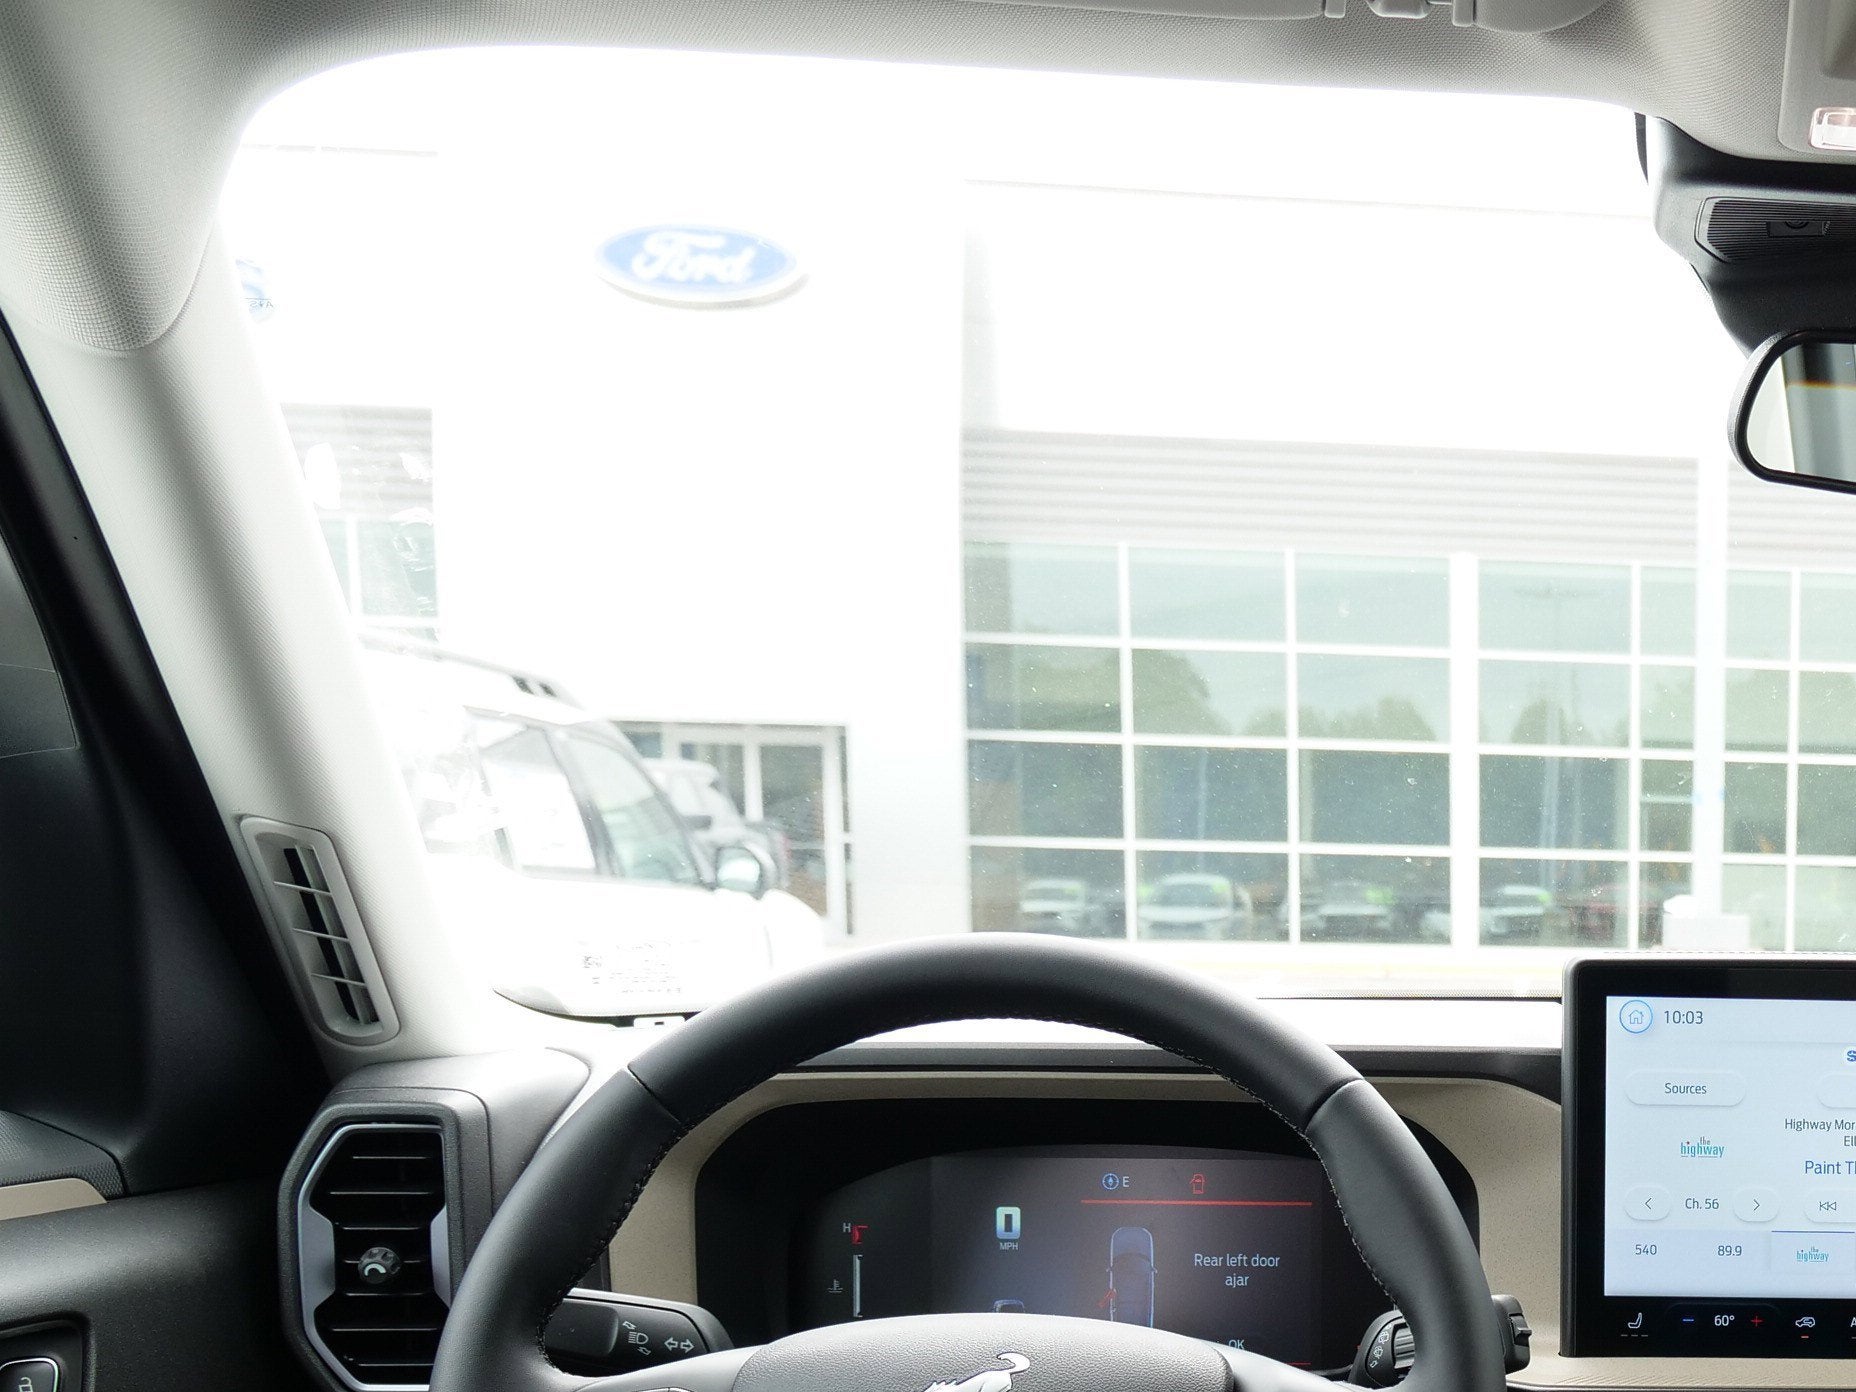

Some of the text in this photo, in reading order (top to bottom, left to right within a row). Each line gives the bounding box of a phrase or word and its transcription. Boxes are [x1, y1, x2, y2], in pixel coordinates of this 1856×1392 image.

[632, 231, 755, 283] Ford
[1663, 1010, 1704, 1025] 10:03
[1664, 1083, 1707, 1095] Sources
[1784, 1118, 1832, 1133] Highway
[1680, 1141, 1725, 1158] highway
[1804, 1160, 1842, 1175] Paint
[1123, 1176, 1130, 1188] E
[1685, 1198, 1720, 1210] Ch. 56
[842, 1222, 851, 1233] H
[999, 1242, 1019, 1251] MPH
[1635, 1244, 1658, 1256] 540
[1717, 1245, 1743, 1257] 89.9
[1194, 1253, 1281, 1268] Rear left door
[1796, 1249, 1830, 1263] highway
[1225, 1273, 1250, 1289] ajar
[1714, 1314, 1735, 1327] 60°
[1228, 1339, 1245, 1350] OK
